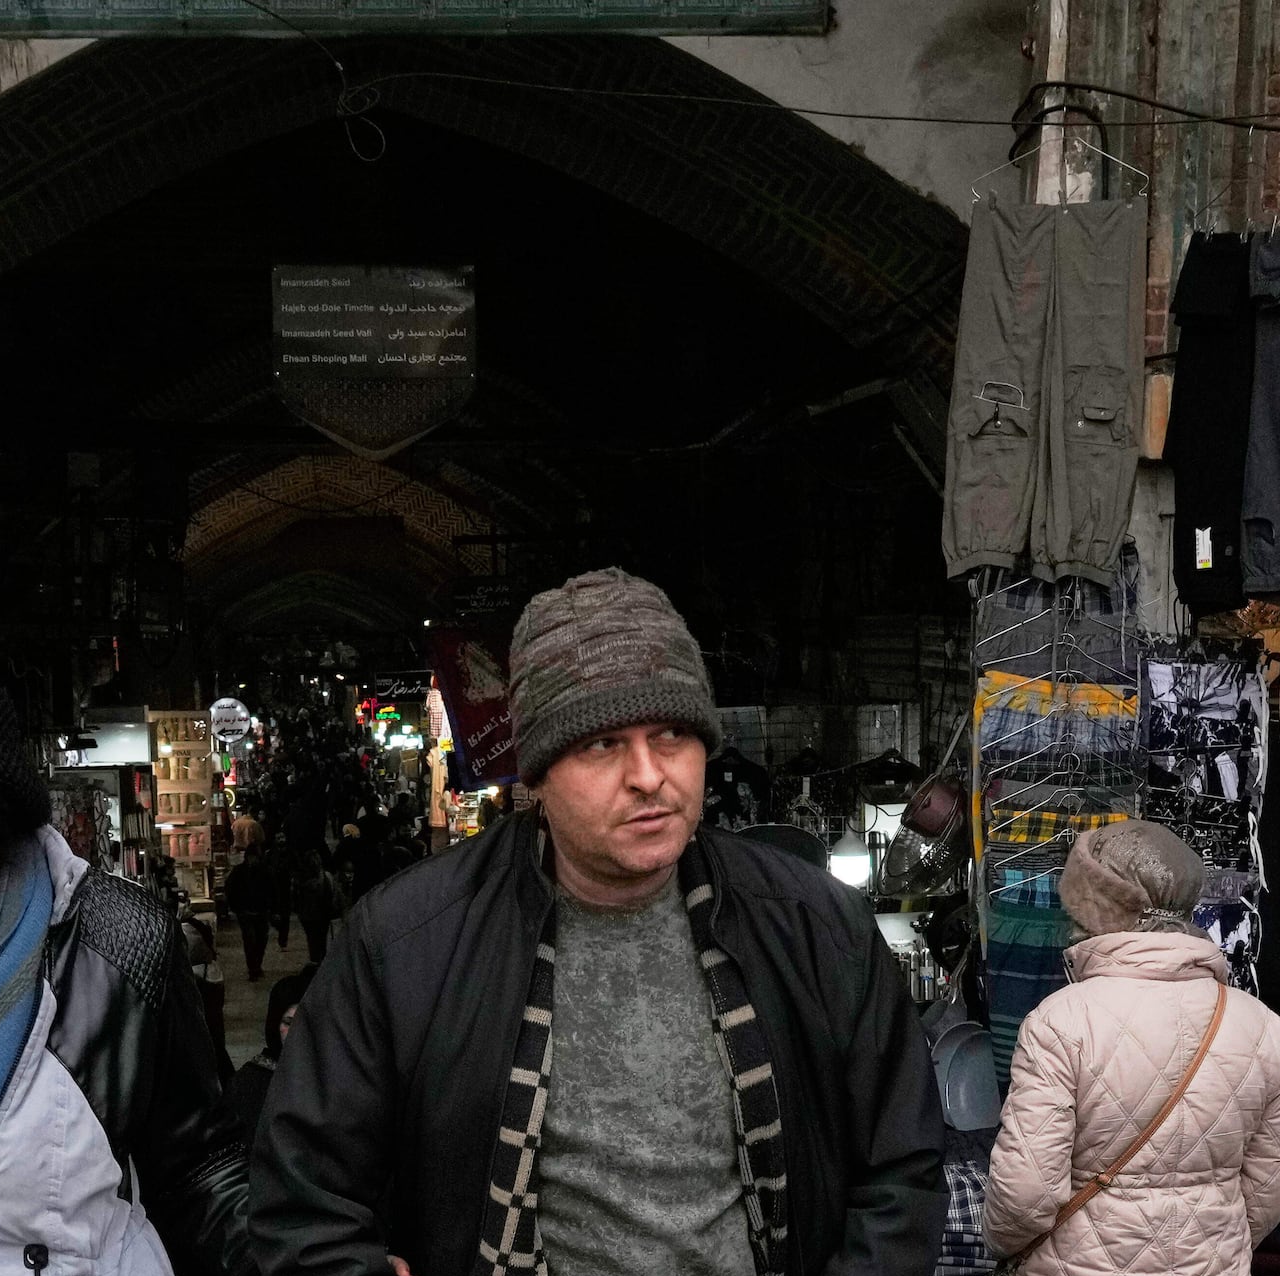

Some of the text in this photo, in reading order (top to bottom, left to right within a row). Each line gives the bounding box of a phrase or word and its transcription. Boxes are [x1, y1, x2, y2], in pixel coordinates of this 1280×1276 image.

[280, 278, 329, 287] Imamzadeh
[428, 278, 466, 289] امامزاده
[281, 304, 306, 314] Hajeb
[408, 304, 437, 314] حاجب
[281, 329, 330, 338] Imamzadeh
[387, 328, 405, 340] ولی
[429, 328, 467, 339] امامزاده
[282, 354, 368, 364] Ehsan Shoping Mall
[377, 353, 467, 365] مجتمع تجاری احسان
